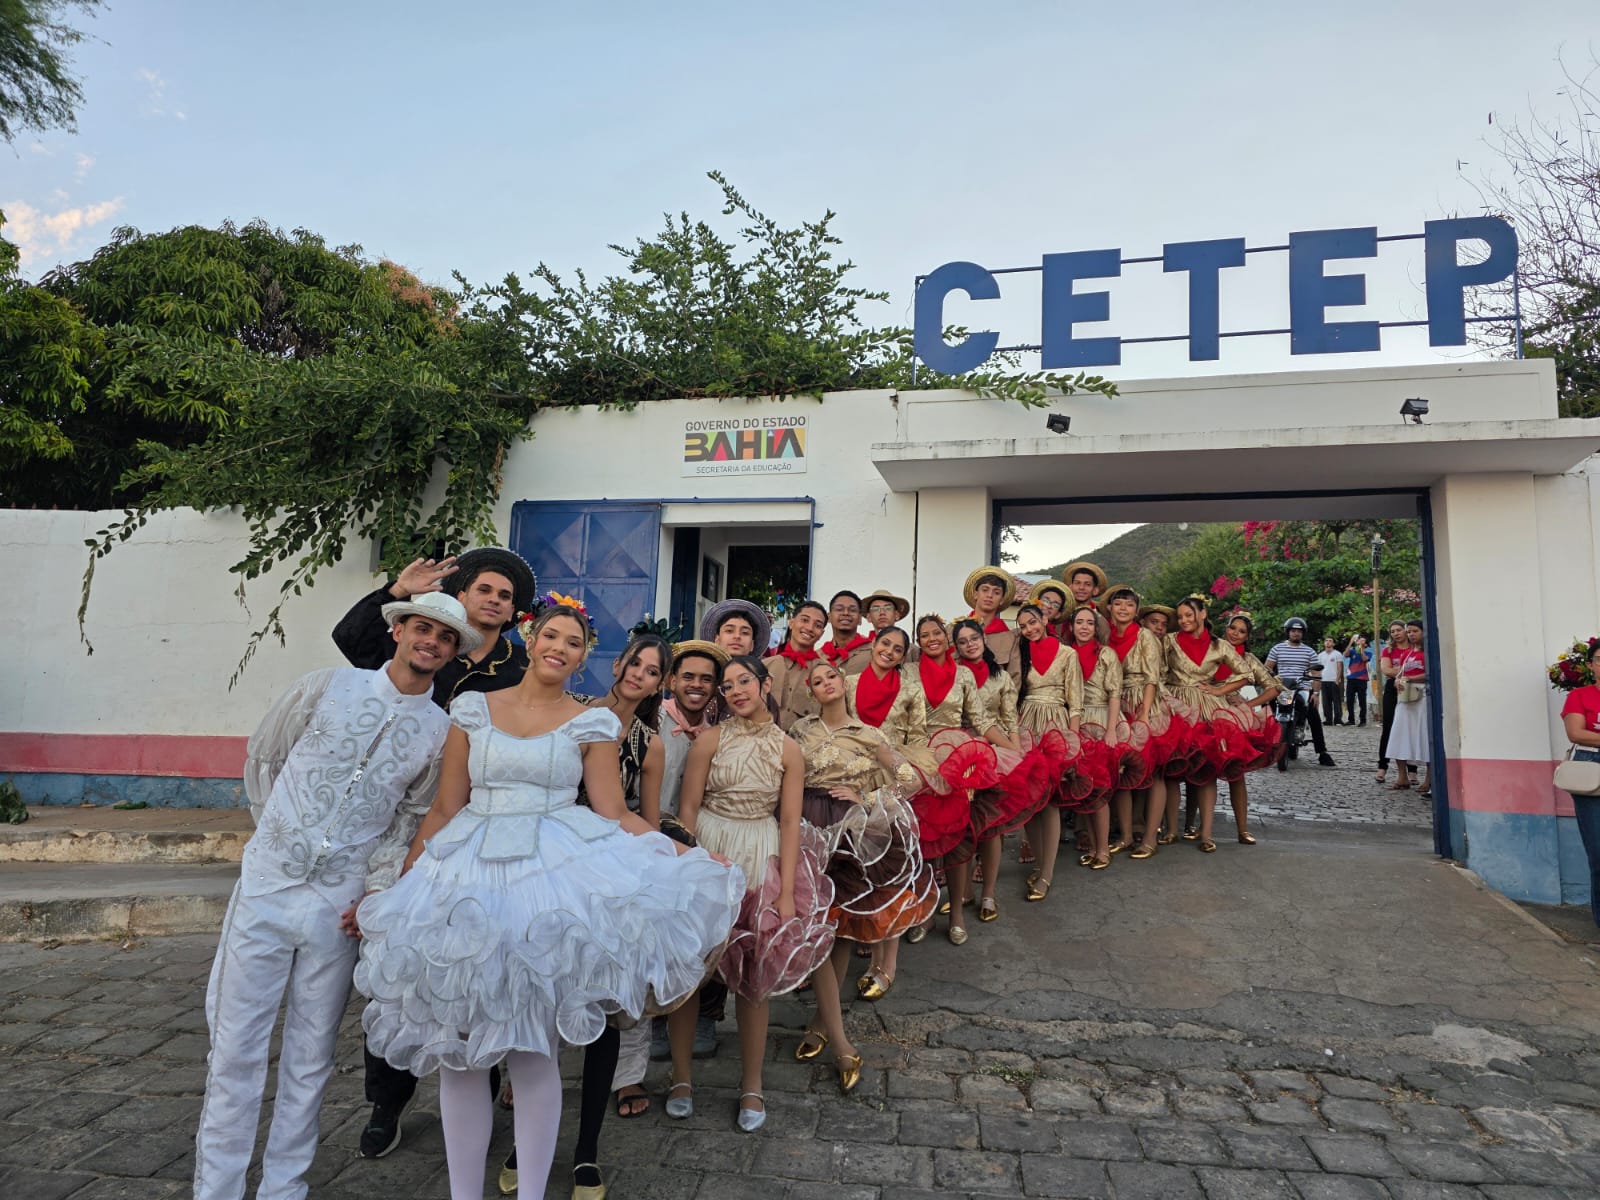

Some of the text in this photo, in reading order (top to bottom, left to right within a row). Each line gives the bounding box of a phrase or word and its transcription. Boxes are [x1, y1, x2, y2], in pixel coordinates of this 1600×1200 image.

[913, 215, 1519, 376] CETEP
[685, 416, 806, 432] GOVERNO DO ESTADO
[684, 428, 805, 462] BAHIA
[696, 462, 792, 474] SECRETARIA DA EDUCAÇÃO
